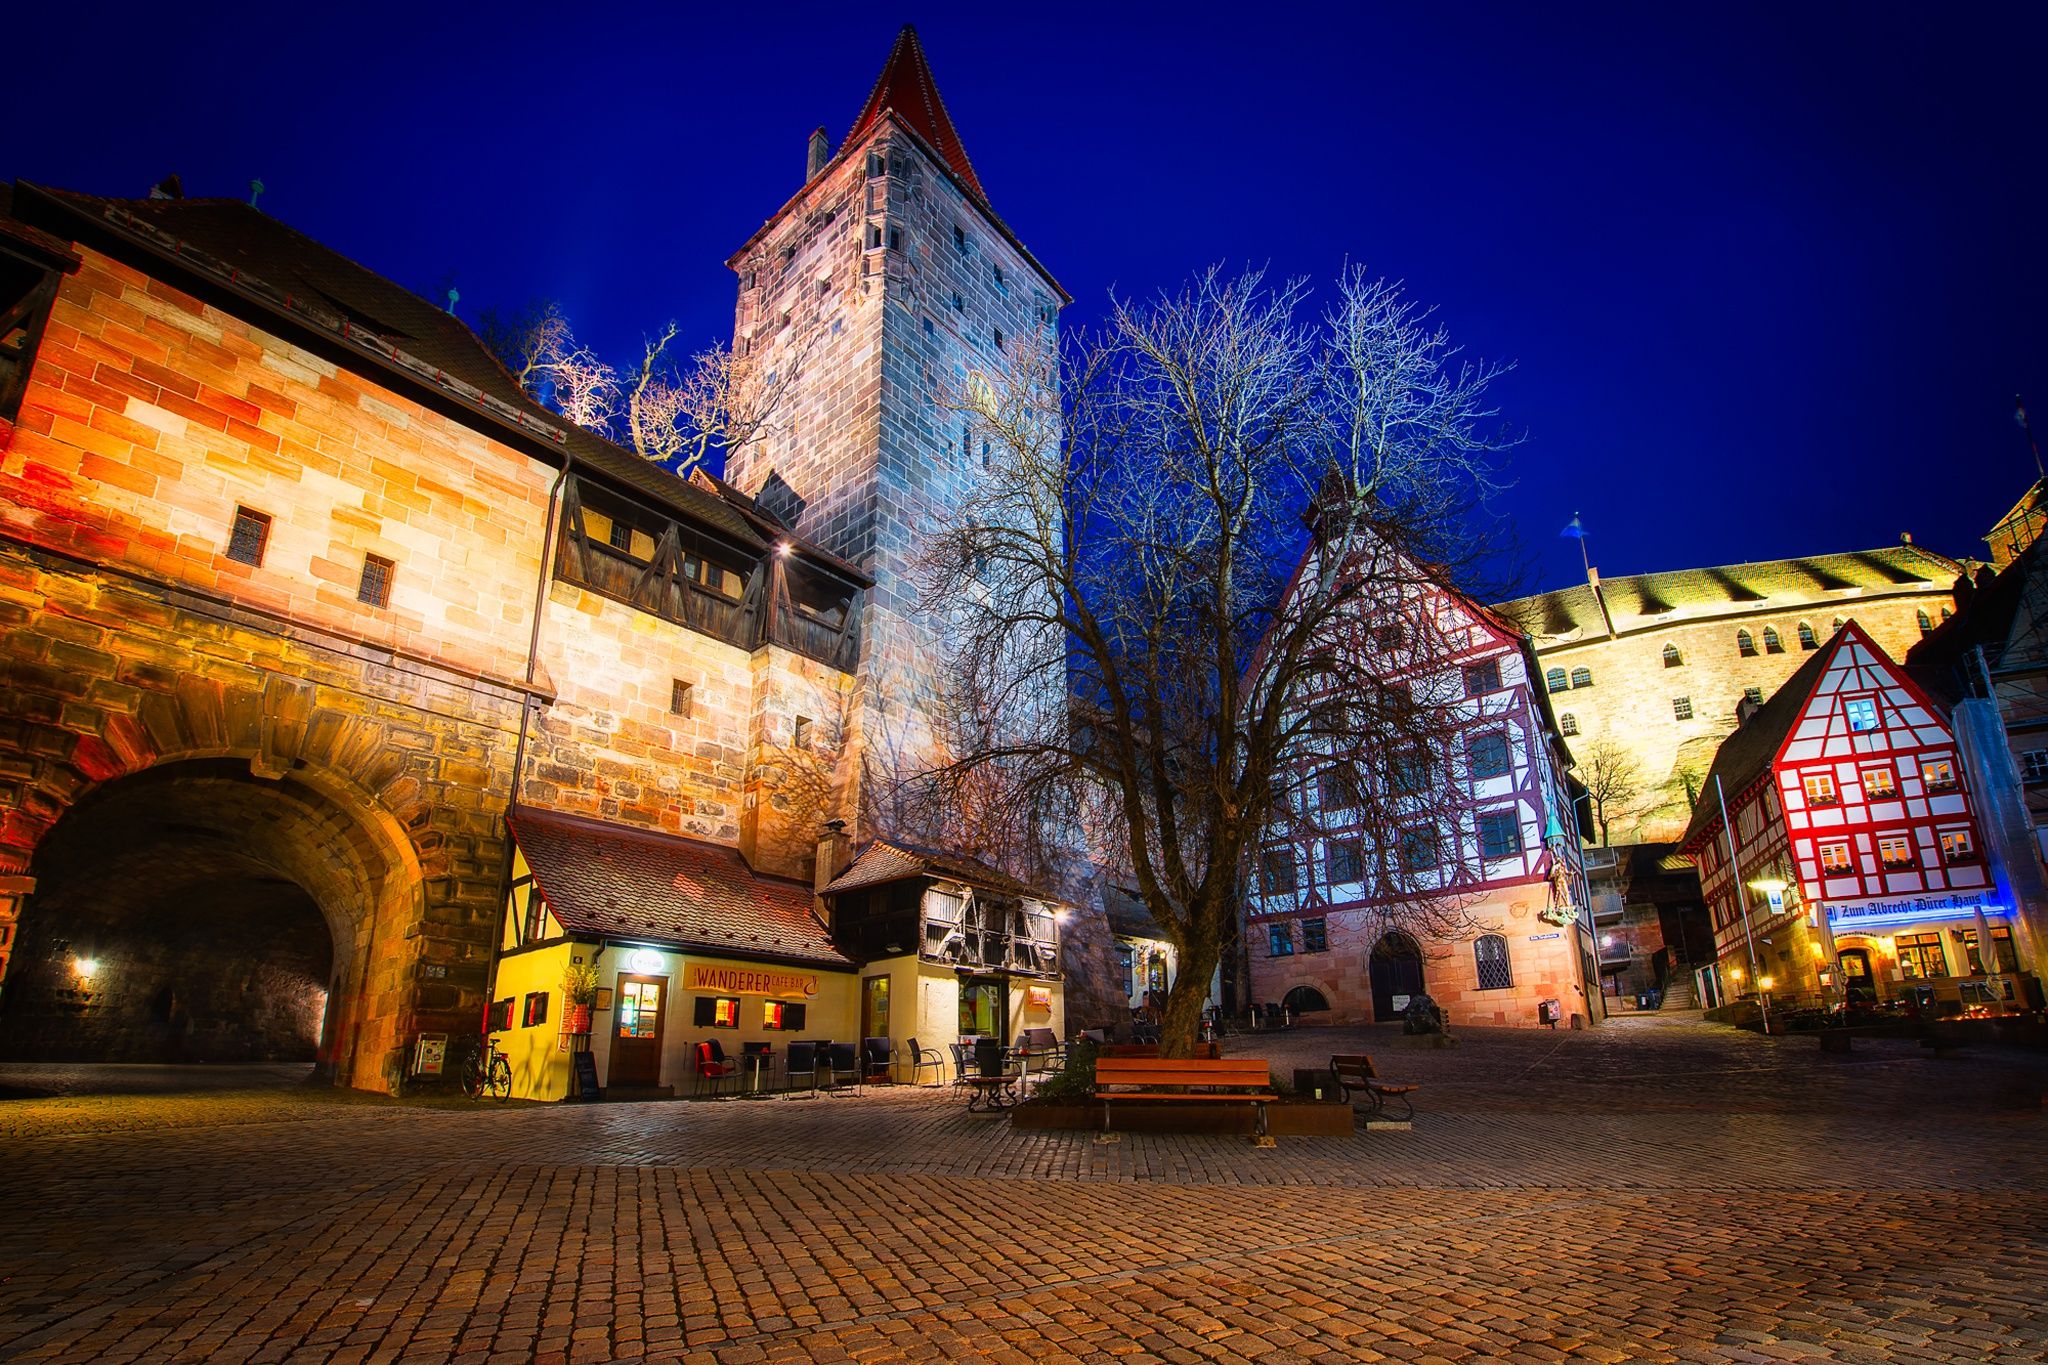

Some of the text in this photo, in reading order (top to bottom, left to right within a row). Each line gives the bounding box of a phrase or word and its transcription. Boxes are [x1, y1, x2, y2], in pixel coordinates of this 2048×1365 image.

[1841, 894, 1981, 918] Zum Albrecht Dürer Haus
[697, 968, 770, 992] WANDERER
[790, 977, 804, 988] BAR
